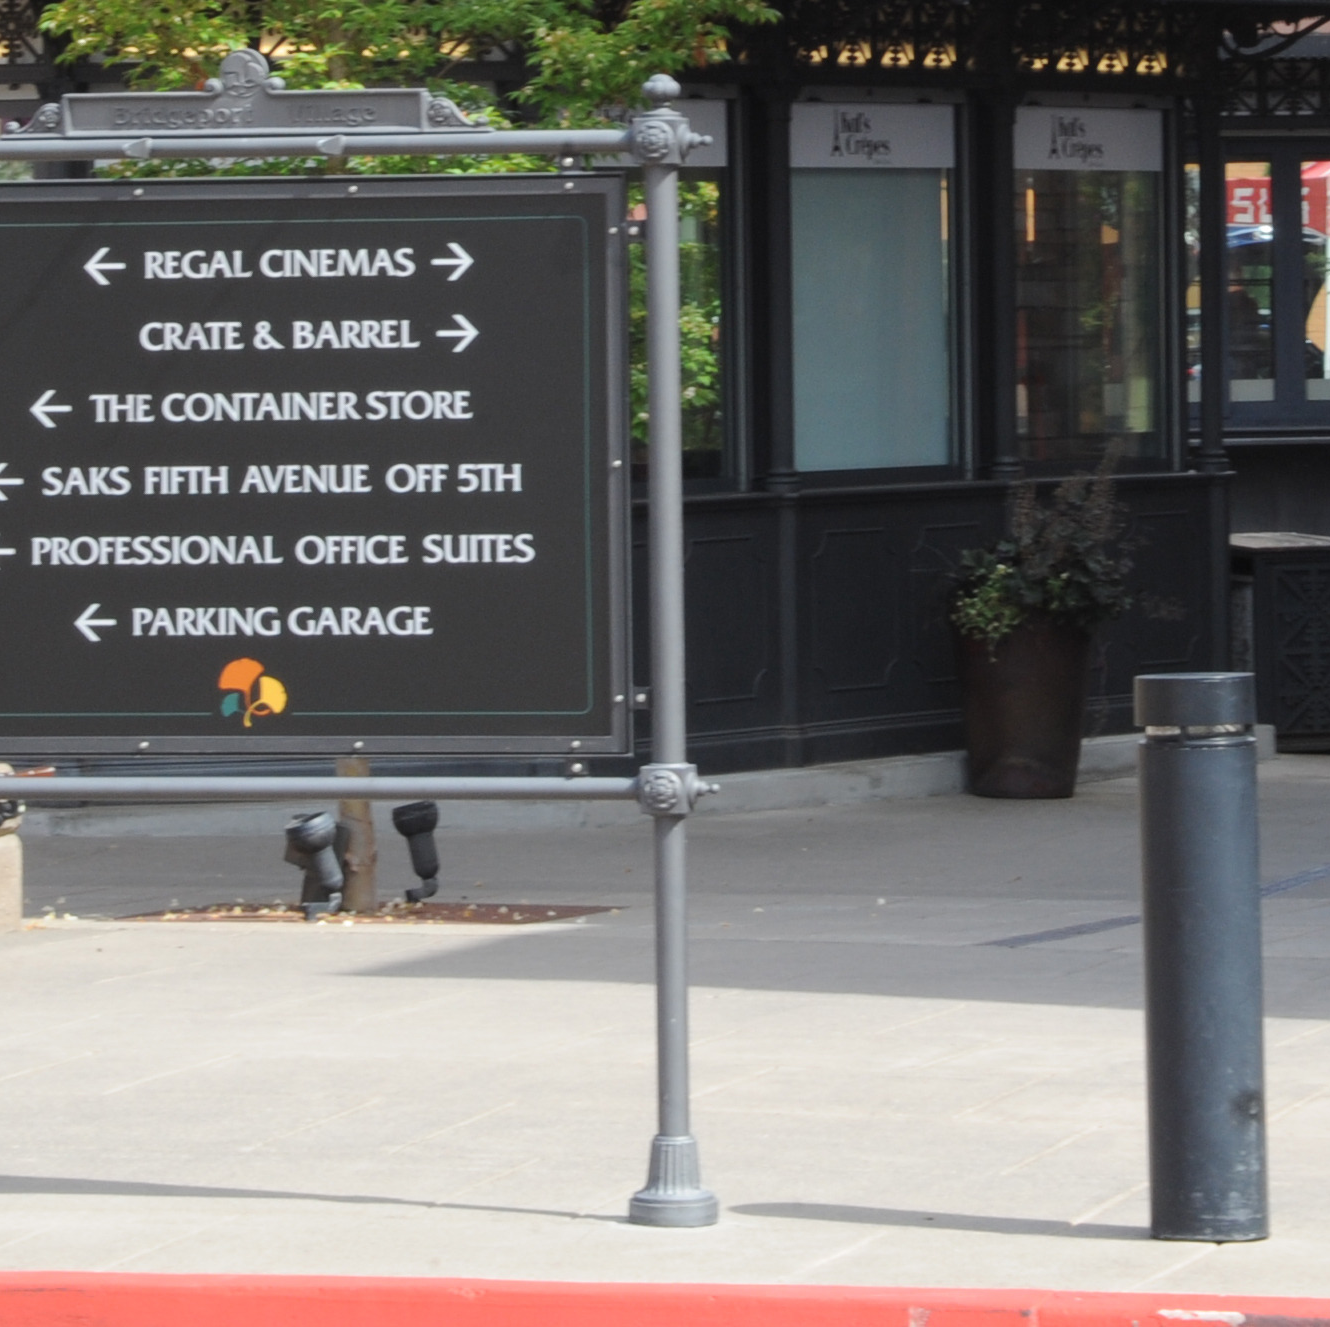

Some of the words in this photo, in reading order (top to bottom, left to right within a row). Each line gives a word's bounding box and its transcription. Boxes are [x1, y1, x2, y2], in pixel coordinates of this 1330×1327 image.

[113, 103, 254, 129] Bridgeport
[292, 103, 377, 127] Village
[144, 249, 253, 280] REGAL
[259, 247, 417, 279] CINEMAS
[138, 321, 245, 352] CRATE
[252, 320, 285, 351] &
[292, 319, 421, 350] BARREL
[88, 393, 156, 423] THE
[161, 391, 363, 423] CONTAINER
[365, 390, 474, 421] STORE
[41, 465, 132, 497] SAKS
[144, 465, 229, 495] FIFTH
[239, 463, 373, 494] AVENUE
[385, 463, 450, 494] OFF
[457, 463, 523, 493] 5TH
[31, 535, 284, 566] PROFESSIONAL
[294, 534, 409, 565] OFFICE
[422, 533, 536, 564] SUITES
[131, 606, 281, 637] PARKING
[287, 605, 434, 637] GARAGE
